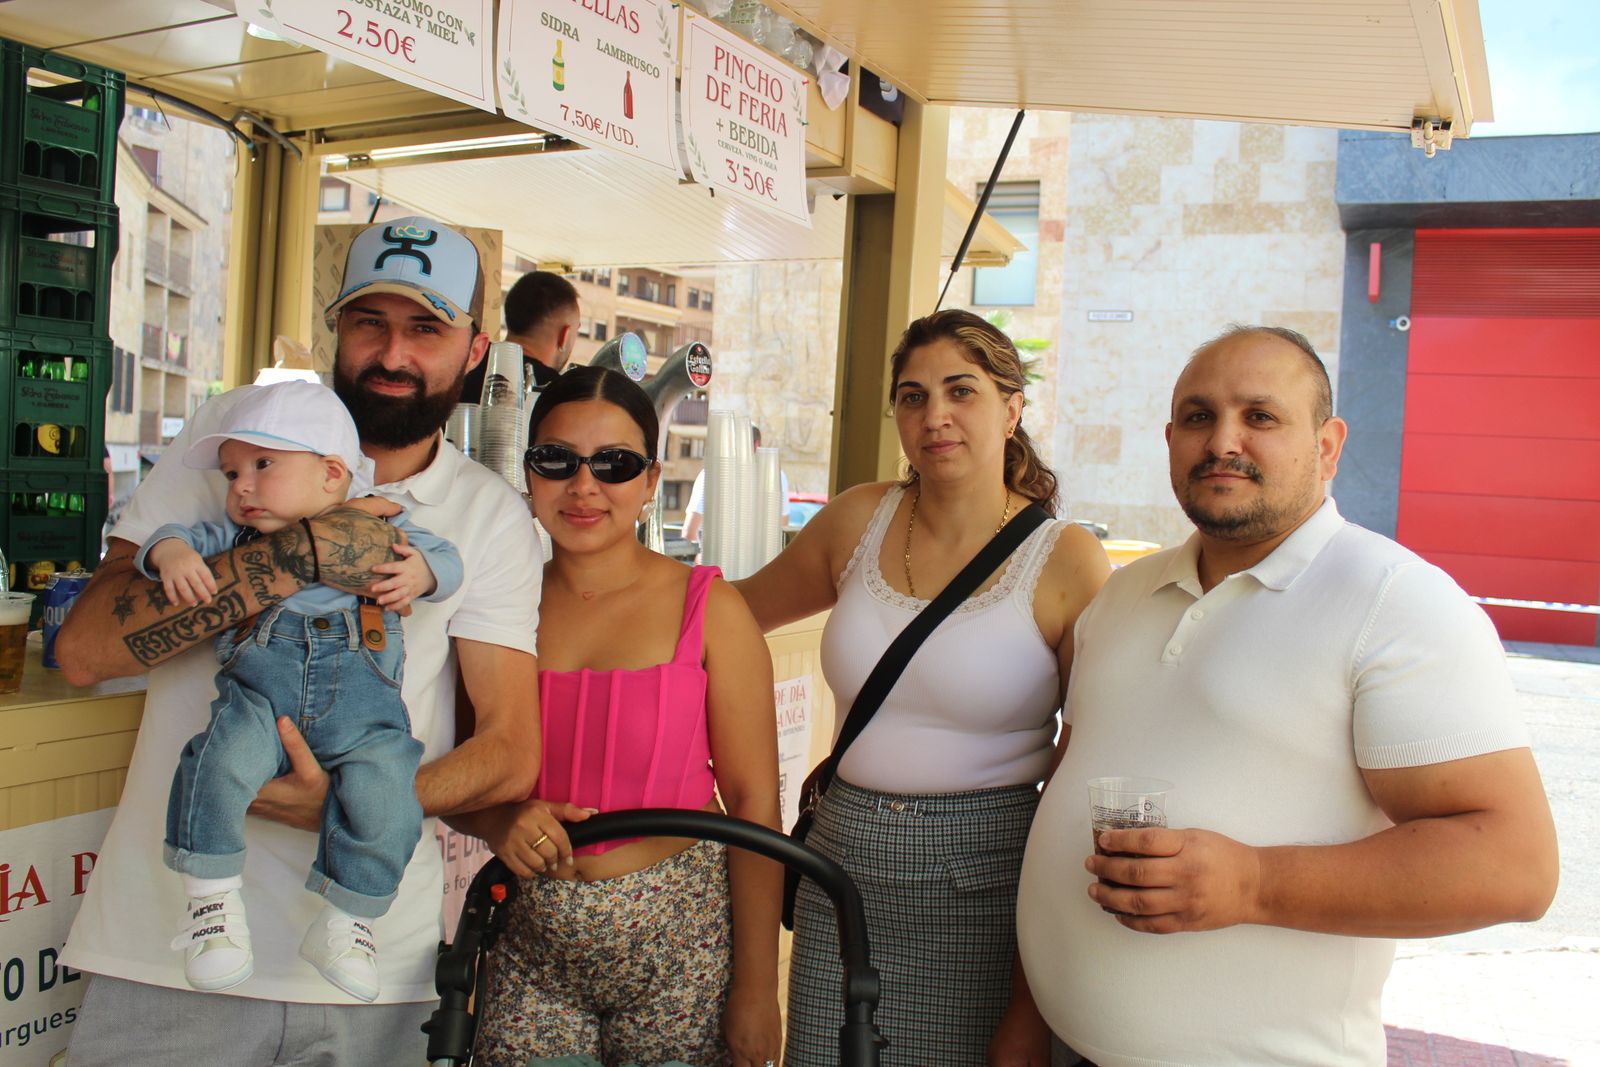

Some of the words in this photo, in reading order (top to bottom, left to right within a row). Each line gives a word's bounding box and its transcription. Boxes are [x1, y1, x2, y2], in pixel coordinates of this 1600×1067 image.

[337, 9, 417, 64] 2,50€
[352, 0, 411, 25] STAZA
[414, 14, 424, 29] Y
[427, 20, 459, 46] MIEL
[437, 10, 463, 32] CON
[570, 0, 640, 34] LLAS
[540, 11, 580, 42] SIDRA
[596, 38, 661, 79] LAMBRUSCO
[714, 45, 784, 103] PINCHO
[560, 104, 639, 148] 7,50€/UD.
[705, 74, 732, 110] DE
[738, 91, 788, 138] FERIA
[729, 120, 779, 161] BEBIDA
[725, 158, 778, 201] 3'50€
[191, 925, 226, 940] MOUSE
[192, 902, 225, 920] MICKEY
